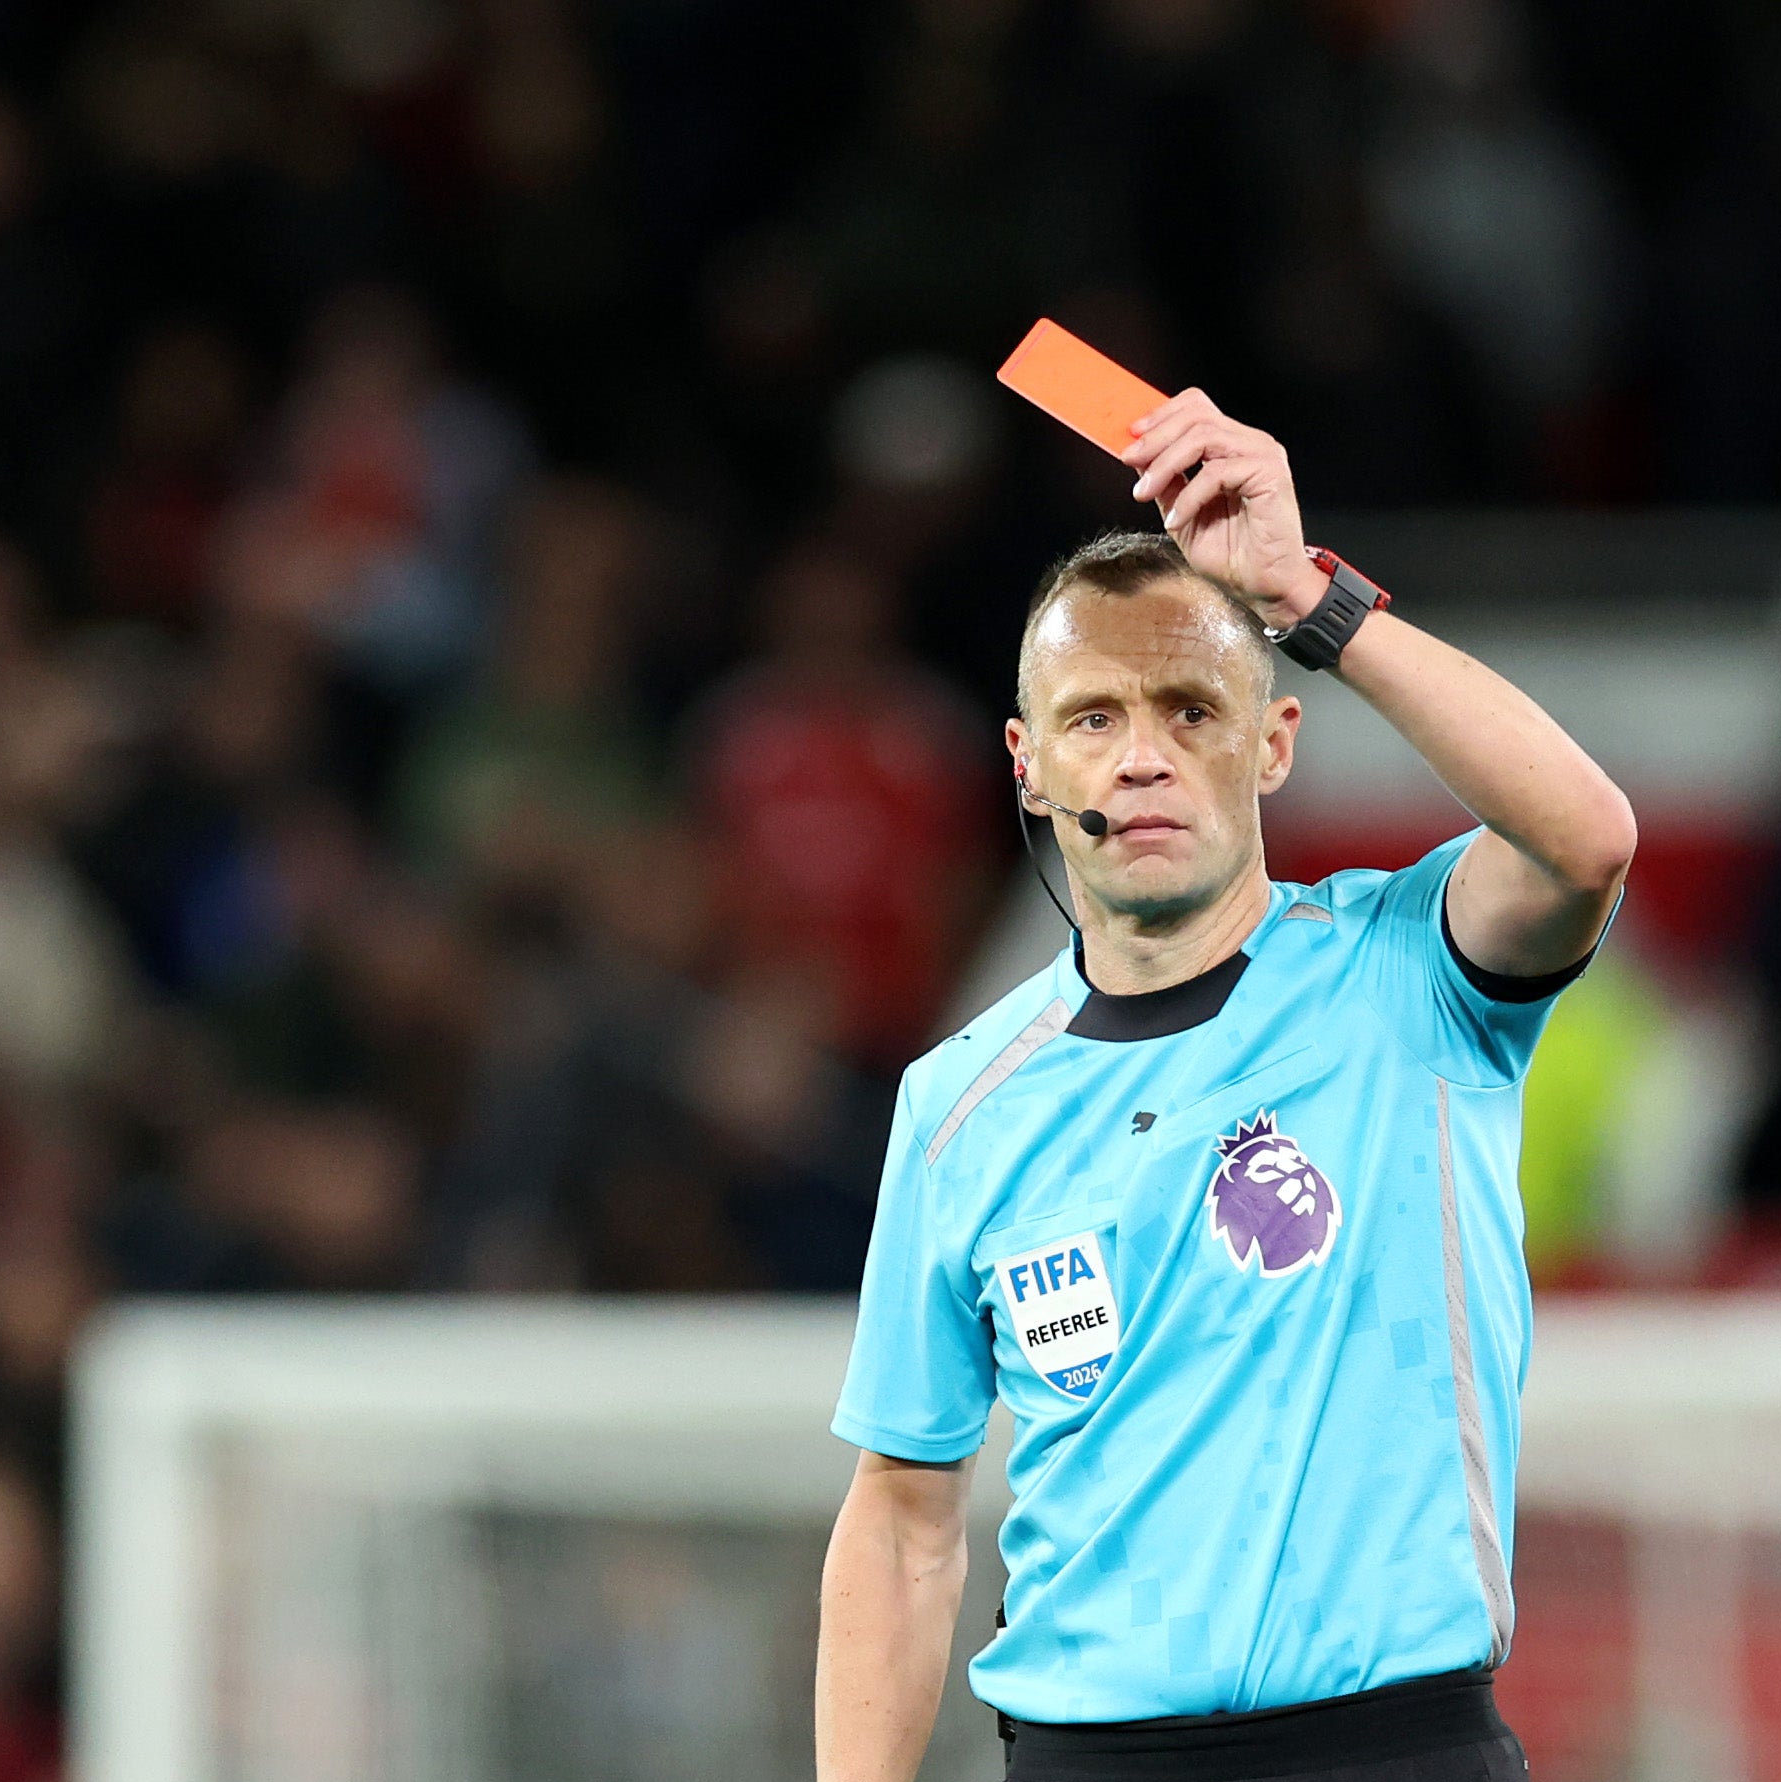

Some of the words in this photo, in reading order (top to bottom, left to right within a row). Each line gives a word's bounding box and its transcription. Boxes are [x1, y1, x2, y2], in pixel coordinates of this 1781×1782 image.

[1008, 1246, 1096, 1304] FIFA
[1026, 1306, 1110, 1348] REFEREE
[1062, 1362, 1103, 1390] 2026
